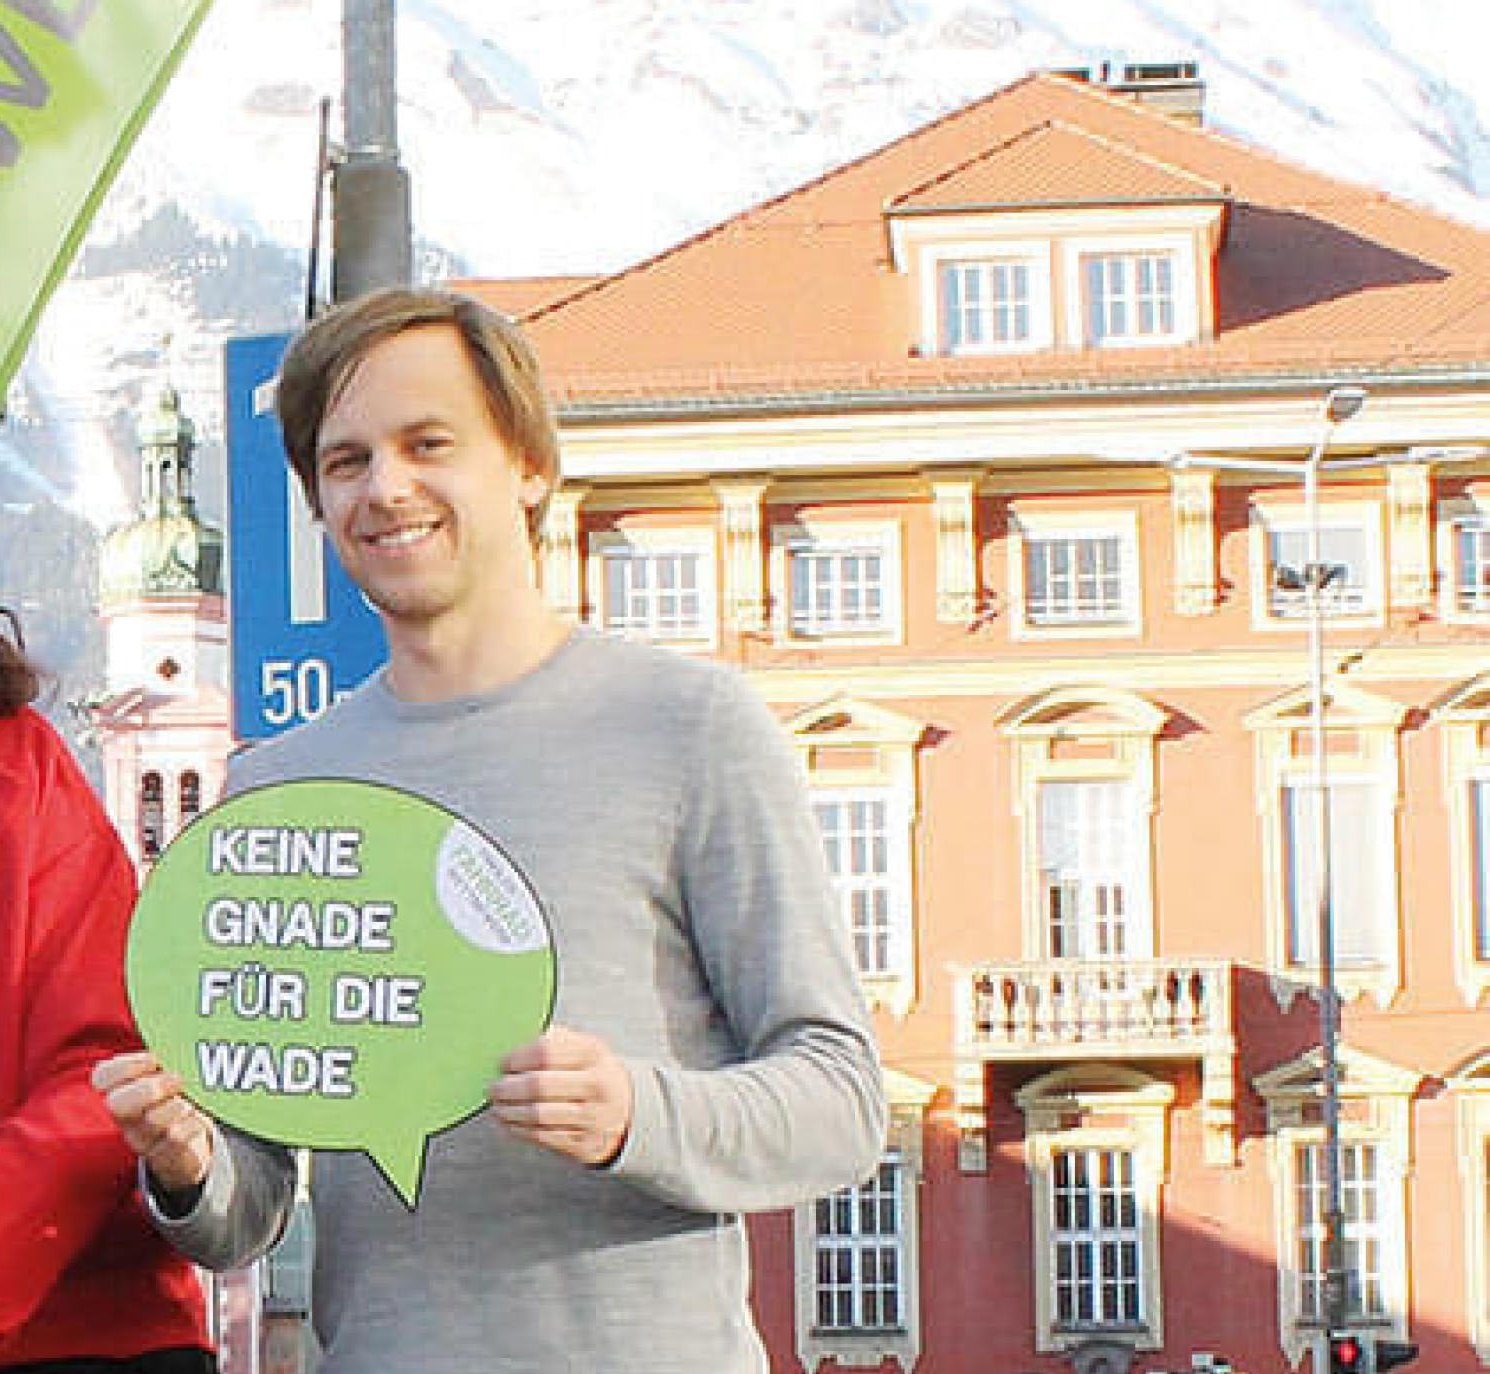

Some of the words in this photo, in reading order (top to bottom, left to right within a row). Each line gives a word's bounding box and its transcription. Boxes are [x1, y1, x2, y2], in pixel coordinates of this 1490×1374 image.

[210, 826, 362, 877] KEINE
[204, 897, 397, 952] GNADE
[197, 961, 307, 1020] FÜR
[330, 973, 424, 1027] DIE
[196, 1039, 357, 1097] WADE
